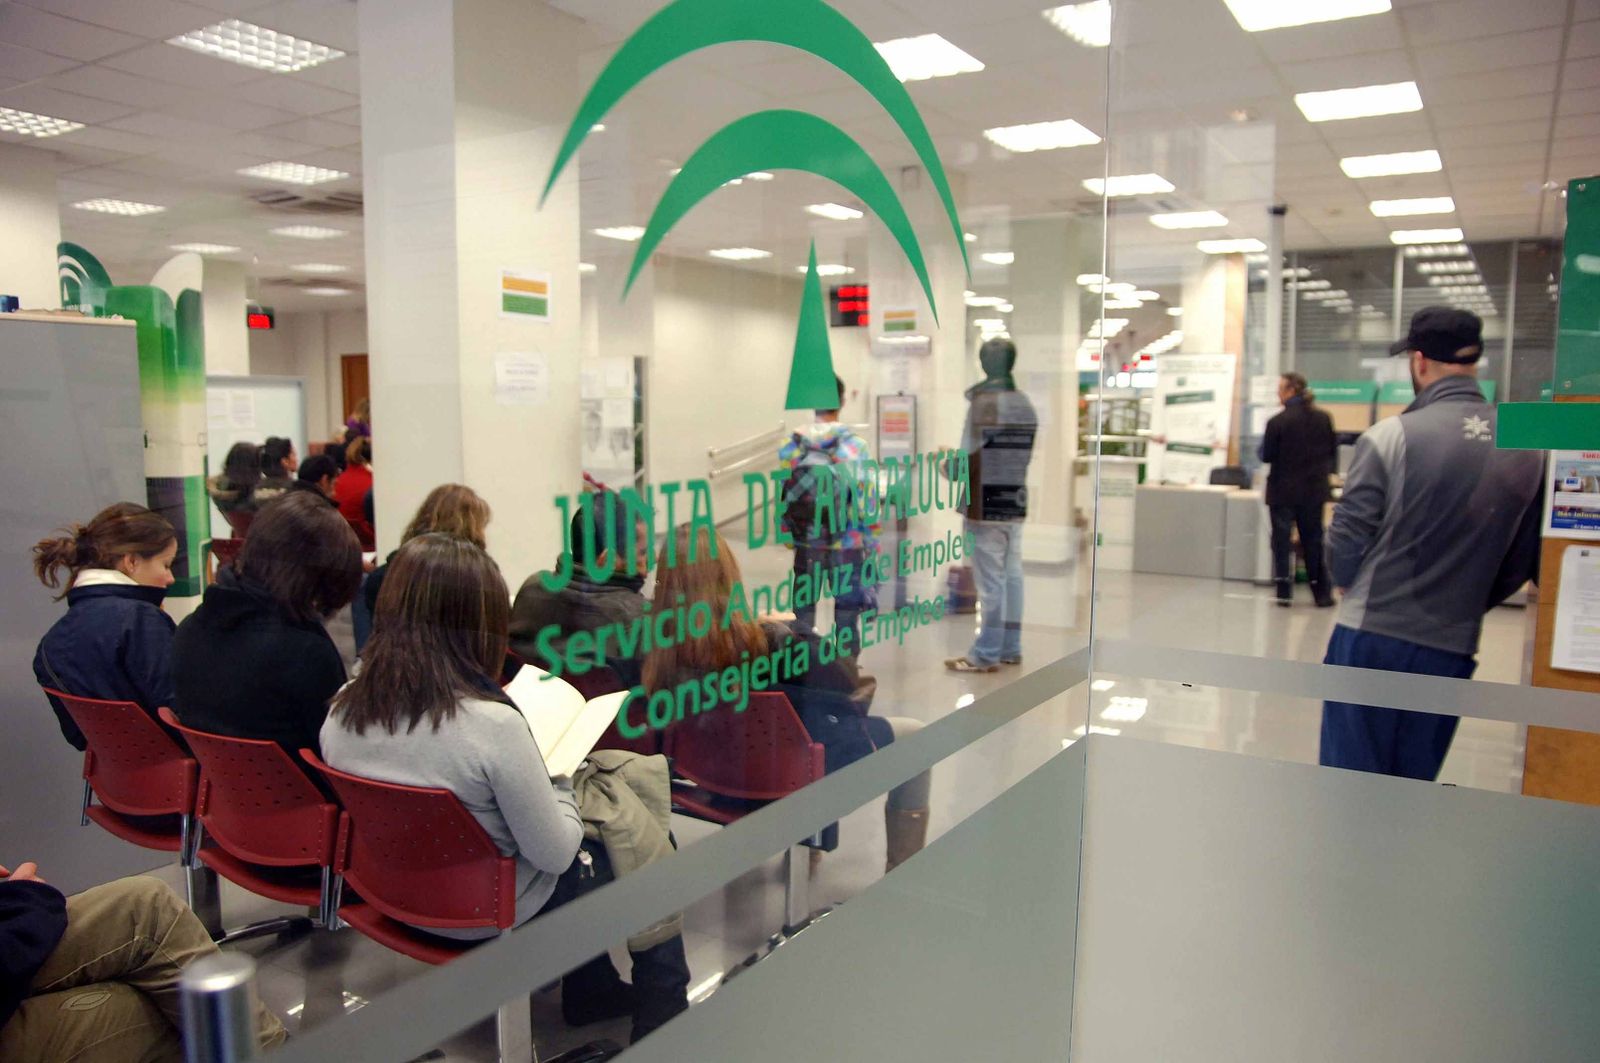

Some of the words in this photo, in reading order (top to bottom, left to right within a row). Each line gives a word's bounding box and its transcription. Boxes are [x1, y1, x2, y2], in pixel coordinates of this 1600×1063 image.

[539, 478, 718, 592] JUNTA
[743, 467, 793, 549] DE
[535, 593, 712, 681] Servicio
[722, 558, 853, 629] Andaluz
[860, 548, 891, 586] de
[898, 529, 976, 576] Empleo
[616, 636, 810, 740] Consejería
[817, 624, 853, 664] de
[860, 594, 945, 646] Empleo
